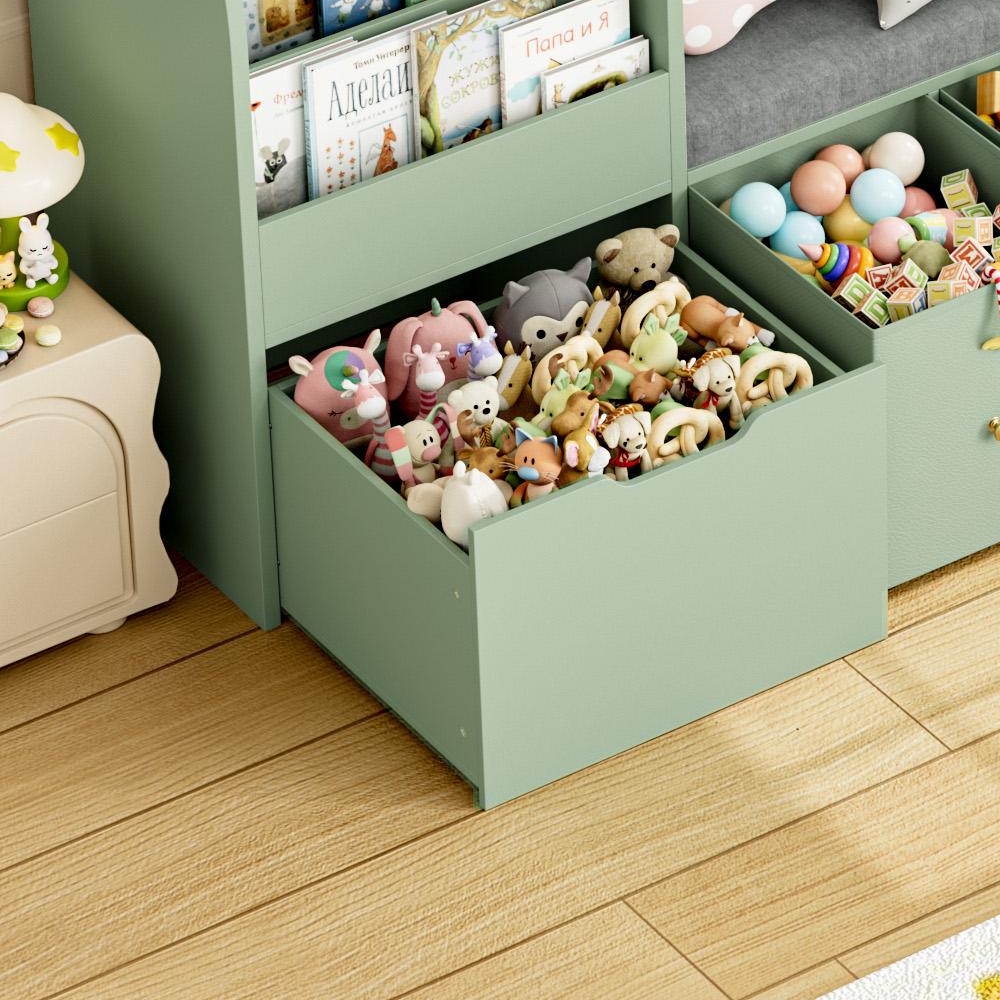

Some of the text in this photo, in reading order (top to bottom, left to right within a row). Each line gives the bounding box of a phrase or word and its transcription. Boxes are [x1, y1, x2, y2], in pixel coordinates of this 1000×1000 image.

[525, 27, 575, 57] Папа
[581, 22, 592, 37] и
[599, 10, 609, 31] Я
[353, 57, 376, 71] Томи
[328, 60, 414, 122] Аделаи
